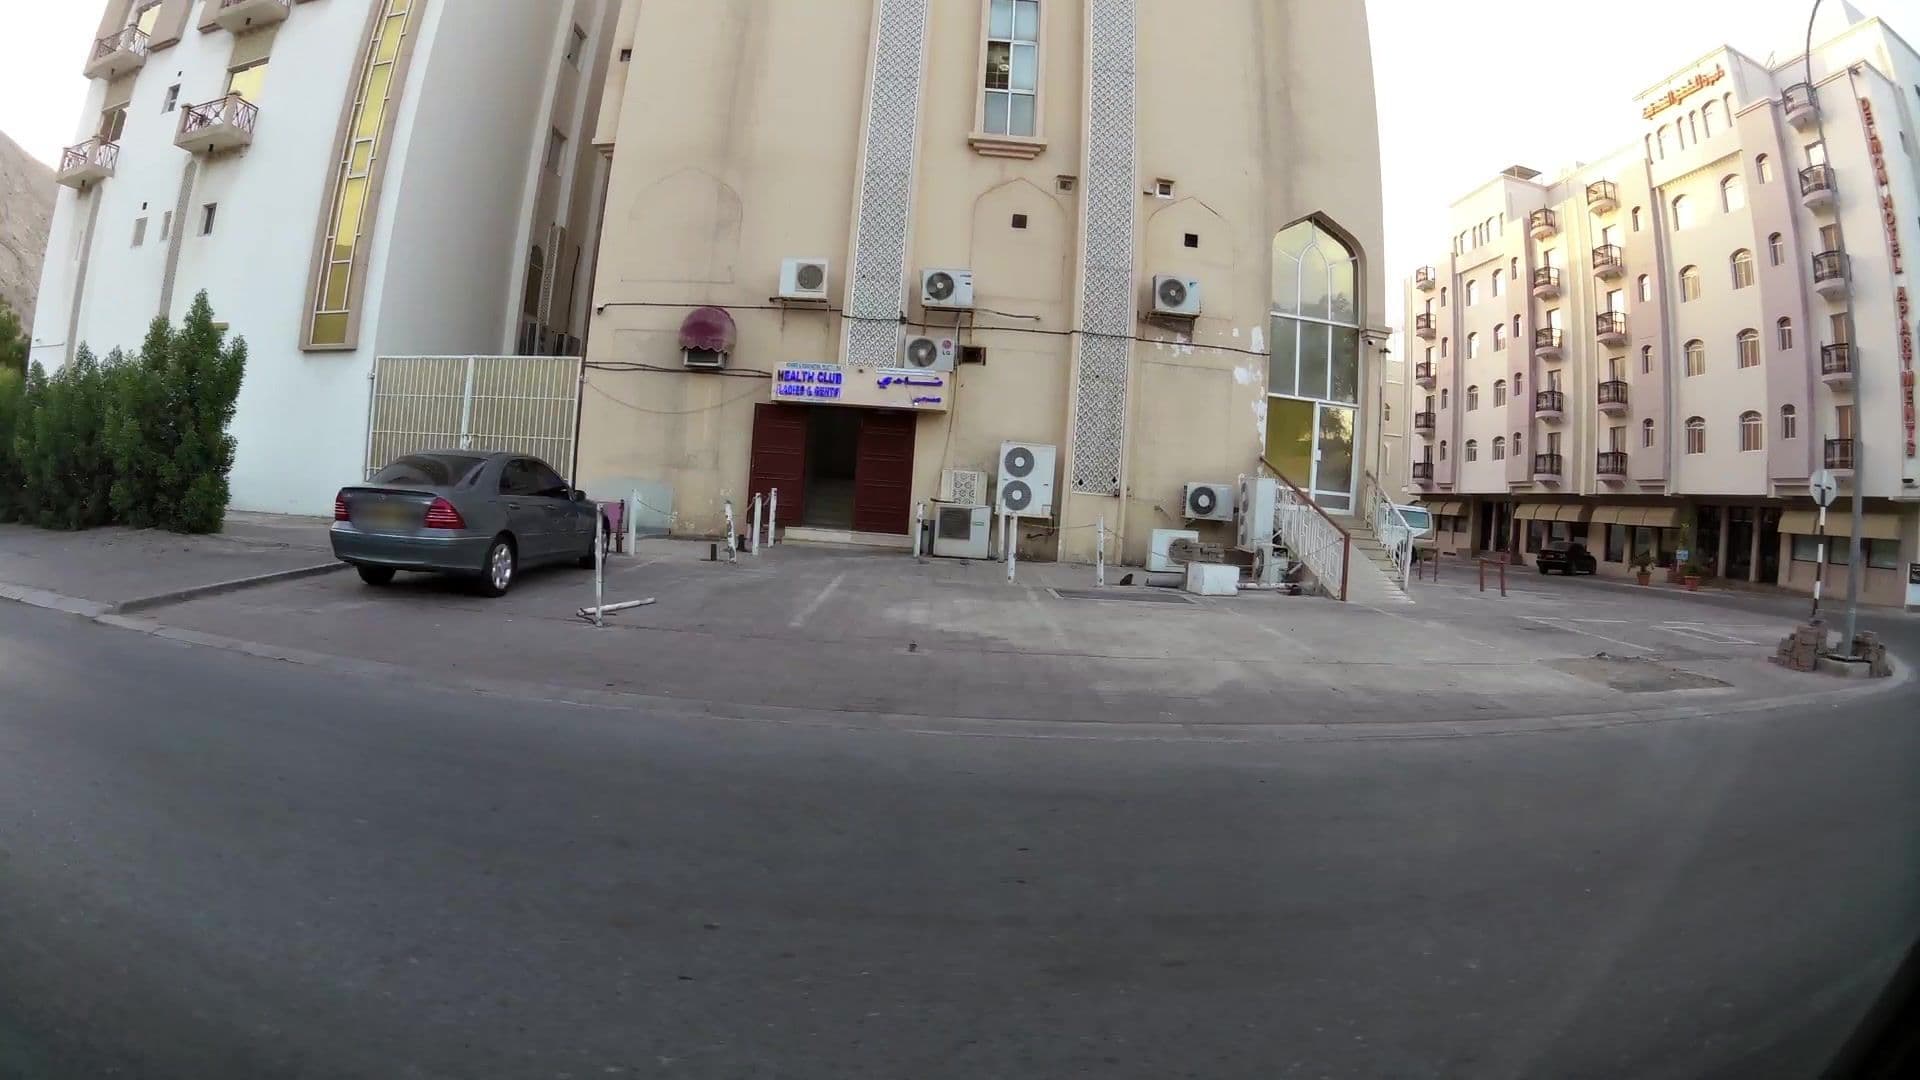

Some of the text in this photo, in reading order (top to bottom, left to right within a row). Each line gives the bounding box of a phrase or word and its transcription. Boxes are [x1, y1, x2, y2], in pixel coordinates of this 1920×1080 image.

[777, 370, 842, 385] HEALTH CLUB
[1895, 286, 1916, 458] APARTMENTS
[778, 385, 805, 397] LADIES
